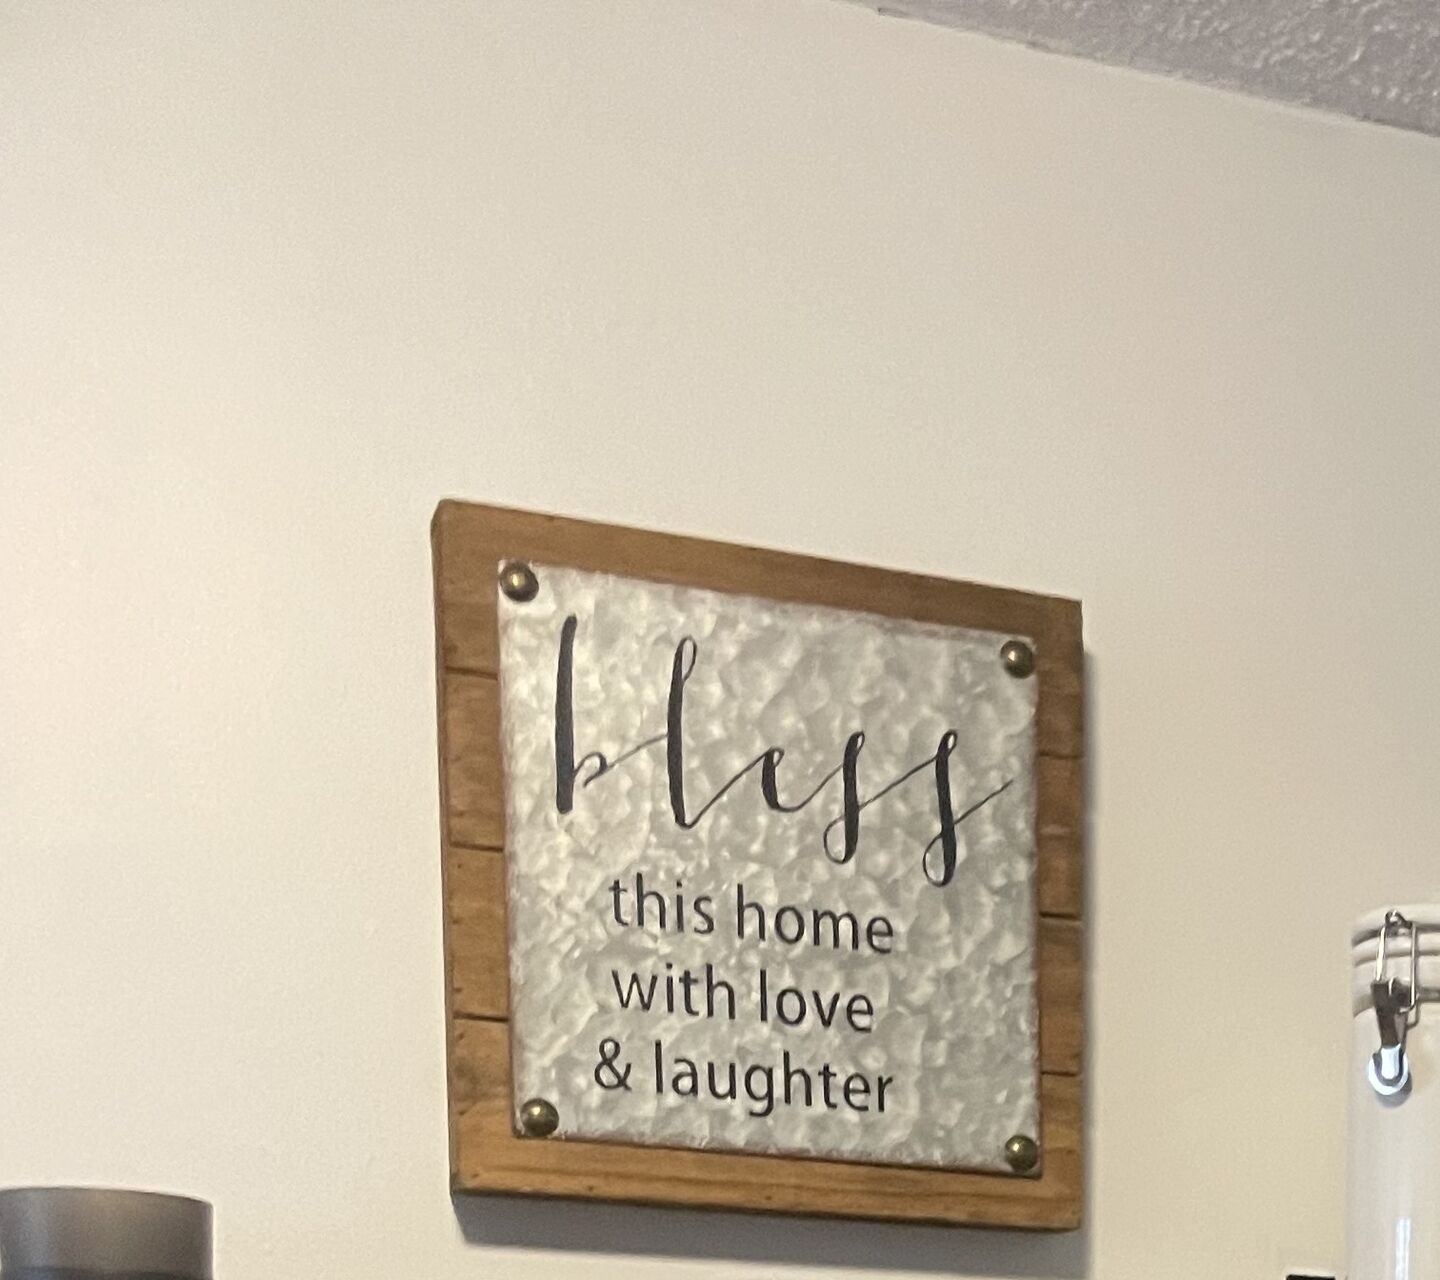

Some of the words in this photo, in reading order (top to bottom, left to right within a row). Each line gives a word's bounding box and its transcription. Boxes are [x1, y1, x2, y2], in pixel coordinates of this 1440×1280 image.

[554, 613, 1014, 888] bless
[609, 872, 715, 936] this
[736, 883, 895, 955] home
[610, 962, 737, 1020] with
[758, 969, 875, 1033] love
[593, 1037, 633, 1092] &
[654, 1040, 895, 1118] laughter
